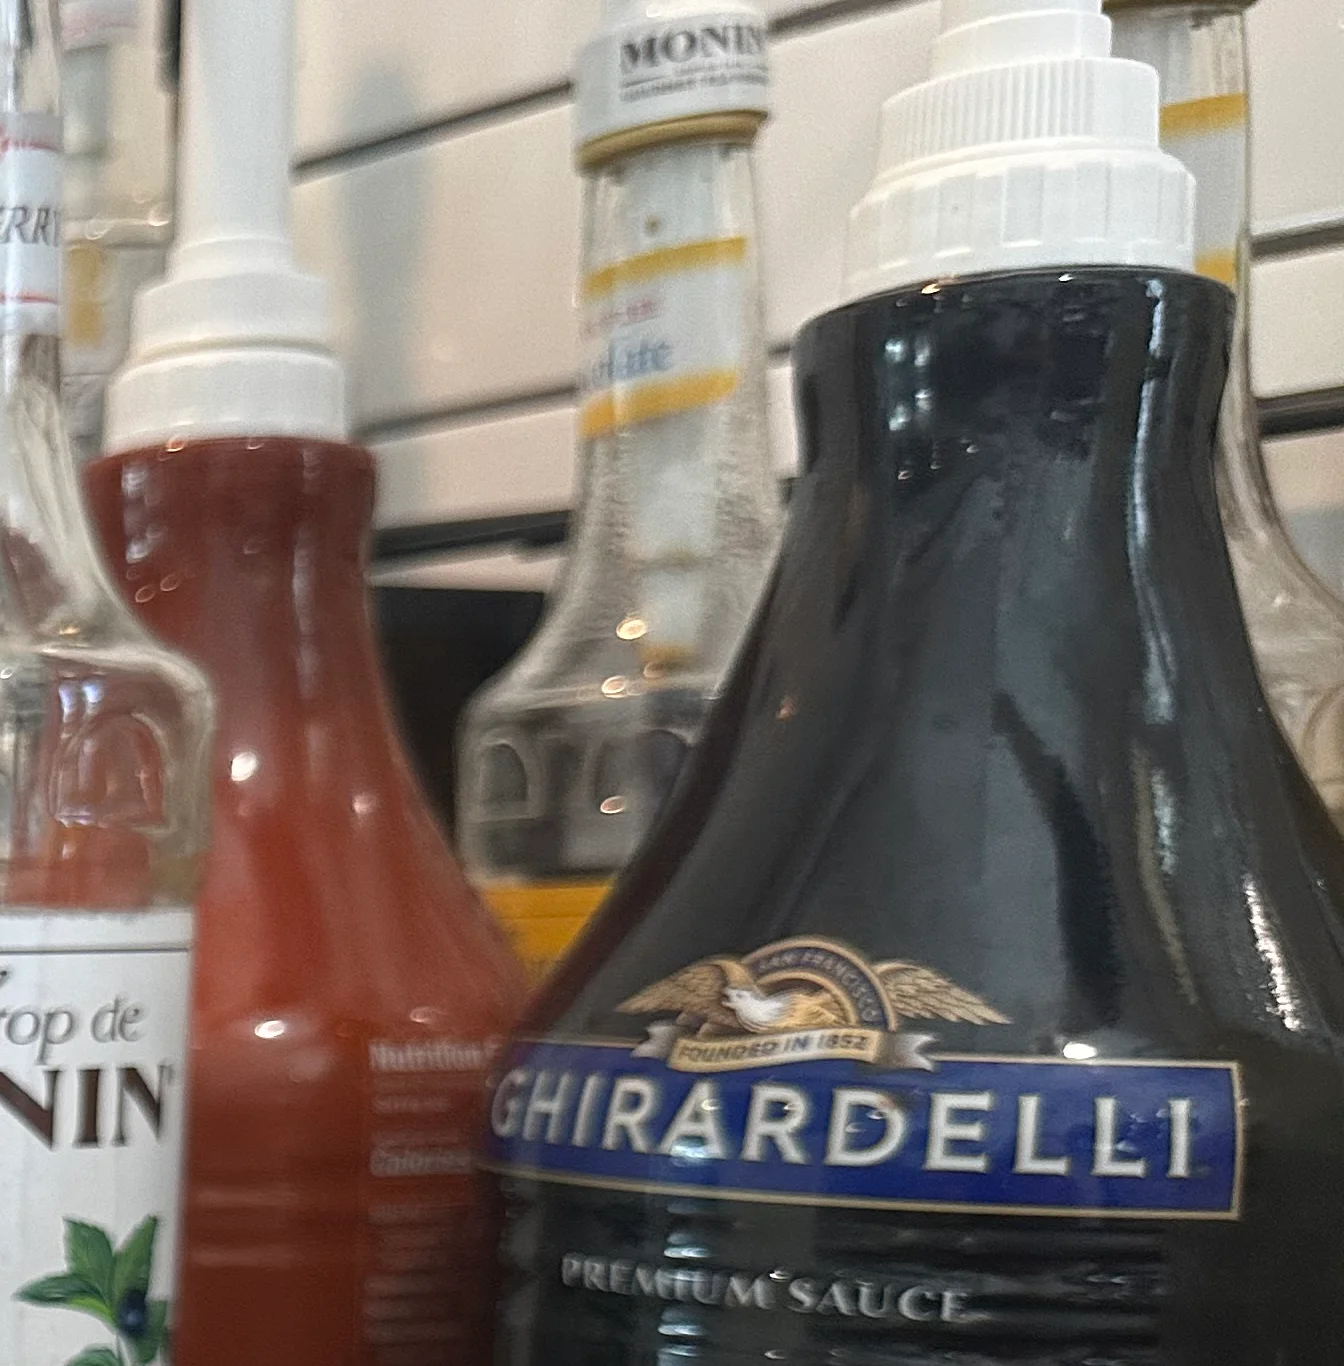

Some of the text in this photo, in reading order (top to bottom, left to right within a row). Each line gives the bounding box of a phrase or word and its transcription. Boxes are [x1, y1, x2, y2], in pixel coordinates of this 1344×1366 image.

[91, 997, 148, 1044] de
[782, 1034, 813, 1053] IN
[817, 1031, 870, 1052] 1852
[491, 1065, 1194, 1178] GHIRARDELLI
[561, 1252, 972, 1322] PREMIUM SAUCE
